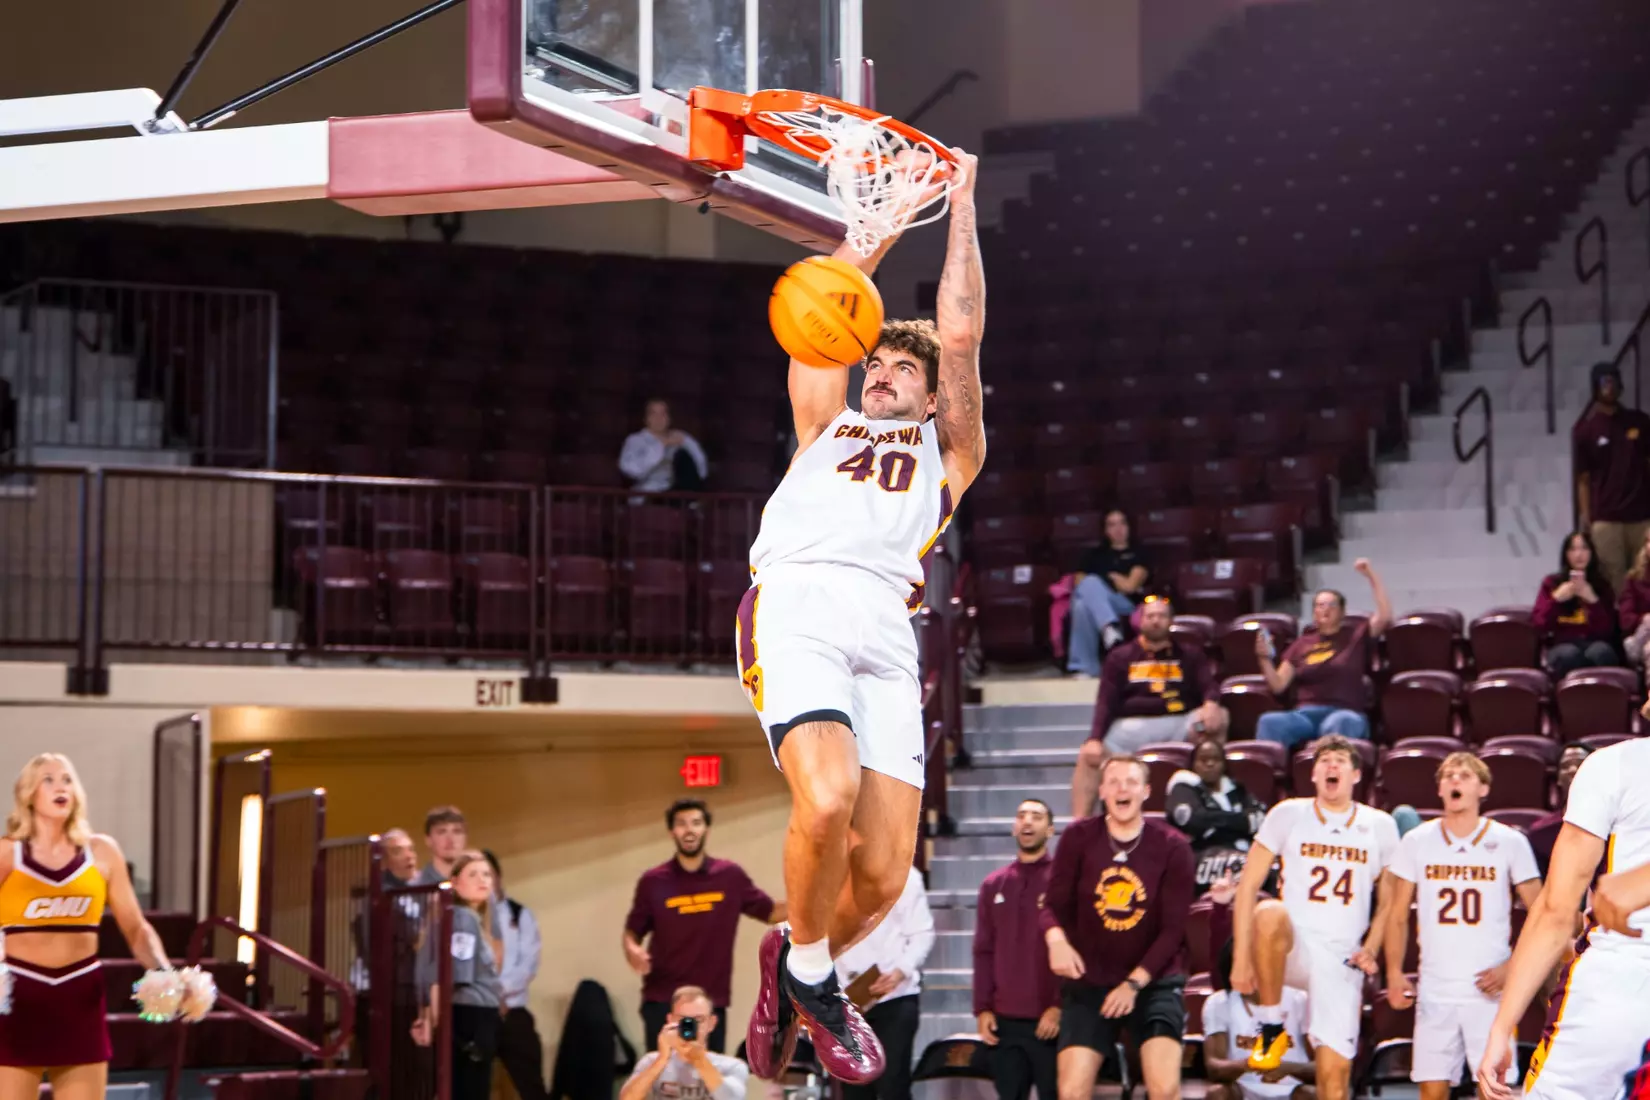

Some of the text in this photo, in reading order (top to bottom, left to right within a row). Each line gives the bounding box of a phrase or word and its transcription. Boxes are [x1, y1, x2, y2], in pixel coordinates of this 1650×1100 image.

[836, 444, 917, 493] 40
[476, 679, 514, 706] EXIT
[686, 757, 718, 786] EXIT
[1300, 842, 1368, 864] CHIPPEWAS
[1307, 865, 1355, 906] 24
[1425, 864, 1496, 882] CHIPPEWAS
[23, 896, 93, 919] CMU
[1437, 887, 1482, 925] 20
